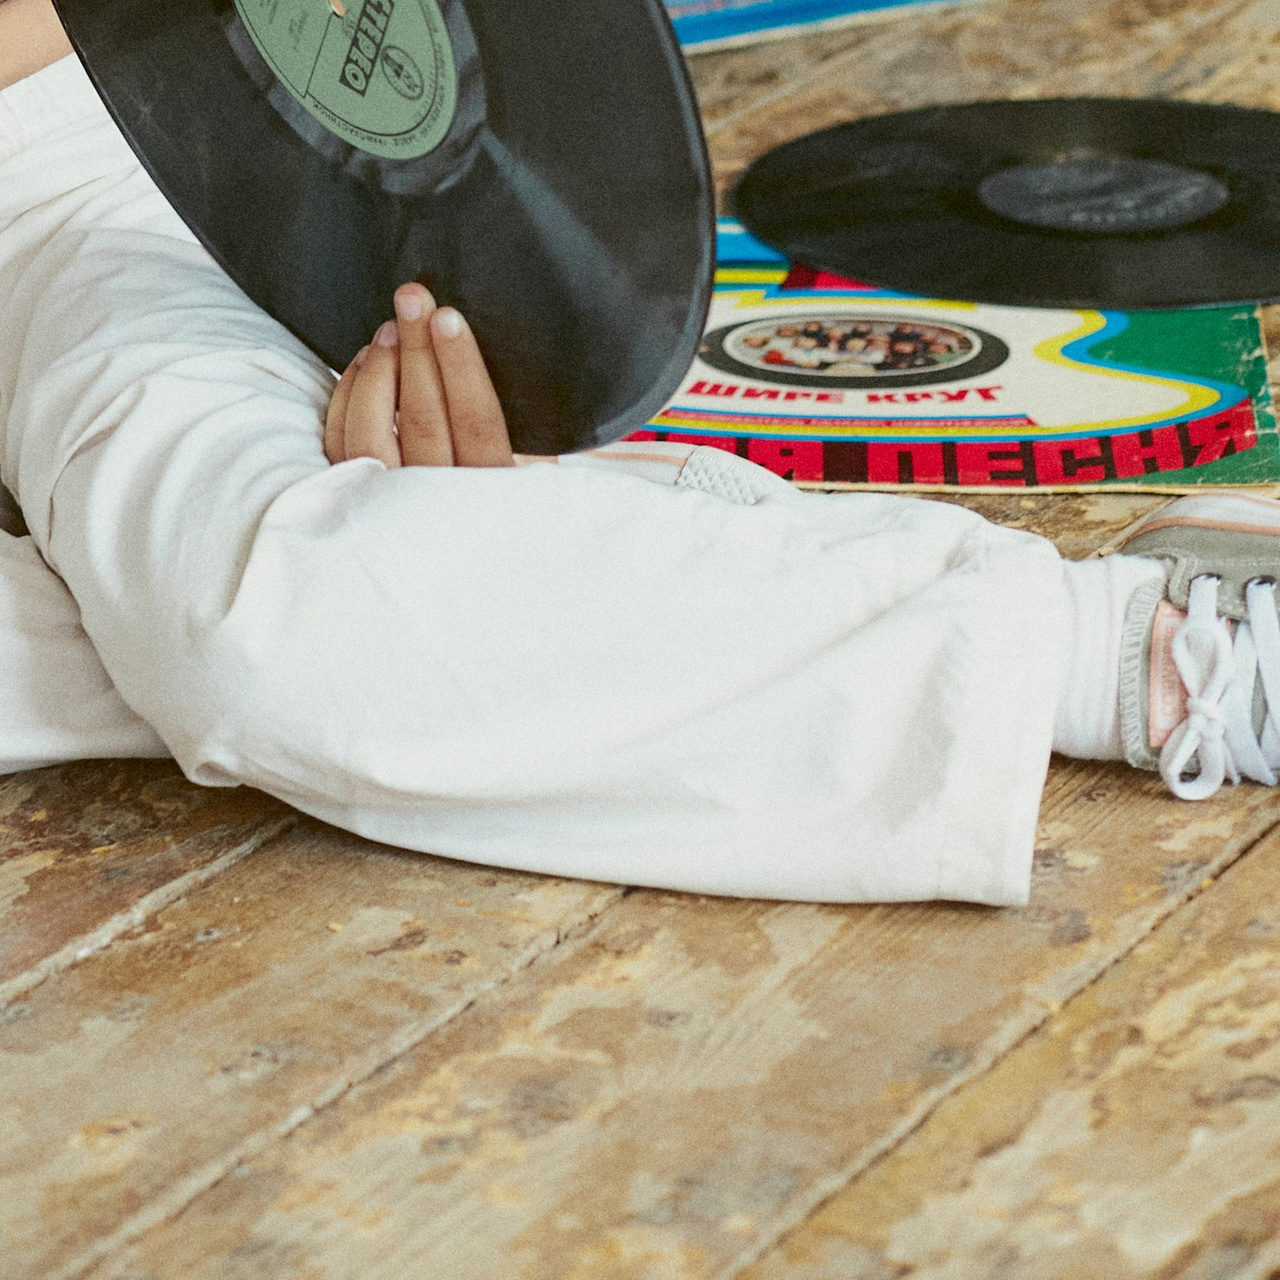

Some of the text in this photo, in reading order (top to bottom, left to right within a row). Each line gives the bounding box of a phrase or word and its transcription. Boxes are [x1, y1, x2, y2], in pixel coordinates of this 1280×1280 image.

[686, 380, 1004, 404] ШИРЕ КРУГ
[867, 397, 1258, 486] ПЕСНЯ
